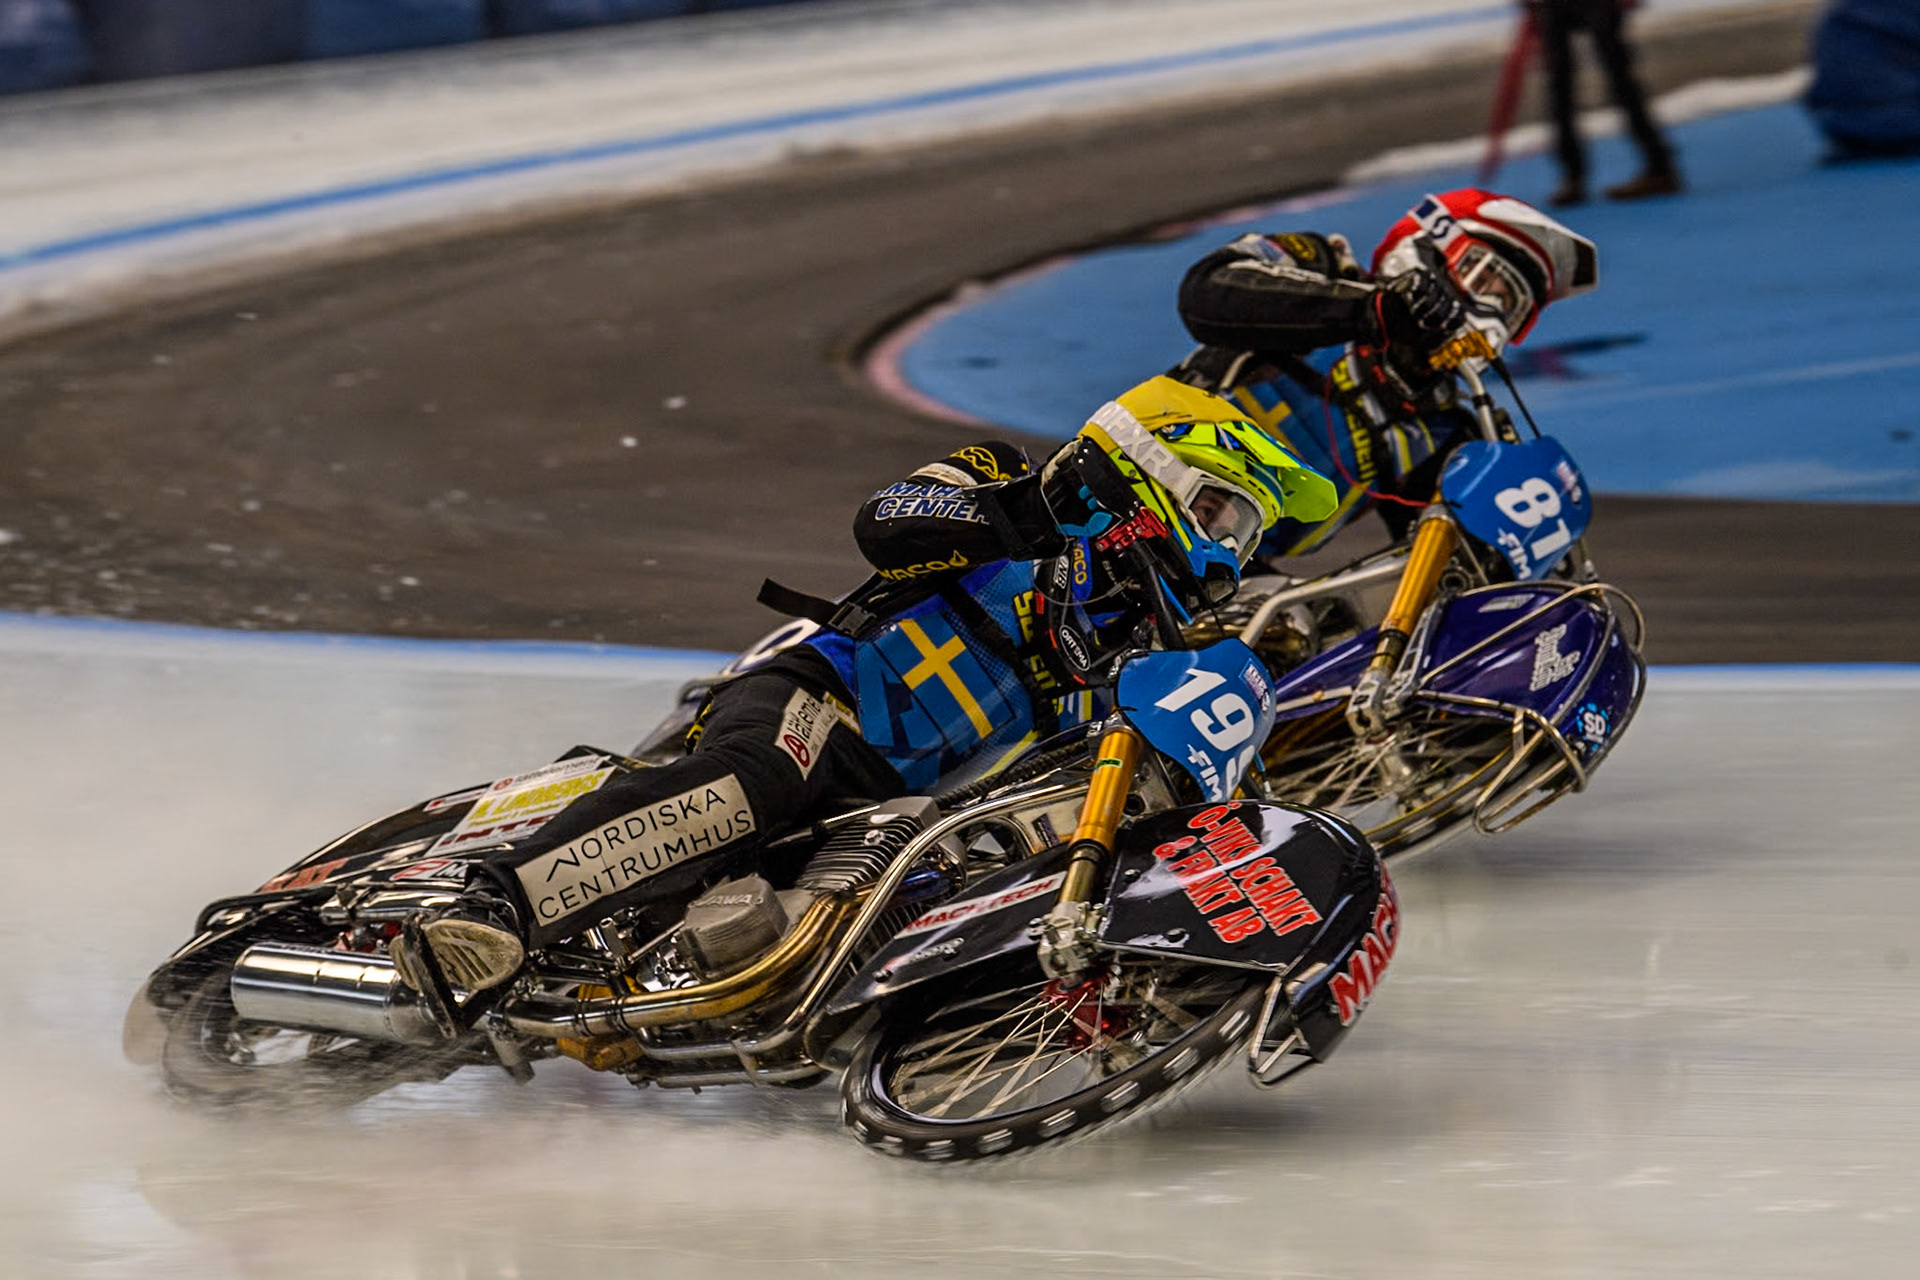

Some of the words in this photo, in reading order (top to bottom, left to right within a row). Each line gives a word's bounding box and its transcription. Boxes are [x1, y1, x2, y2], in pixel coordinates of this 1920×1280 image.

[1495, 478, 1571, 561] 81
[1498, 528, 1531, 580] FIM
[1187, 743, 1223, 802] FIM
[538, 809, 750, 918] CENTRUMHUS
[547, 787, 726, 883] NORDISKA
[1153, 835, 1198, 861] &
[1167, 849, 1245, 914] FRAKT
[1231, 856, 1323, 936] SCHAKT
[1208, 907, 1266, 943] AB
